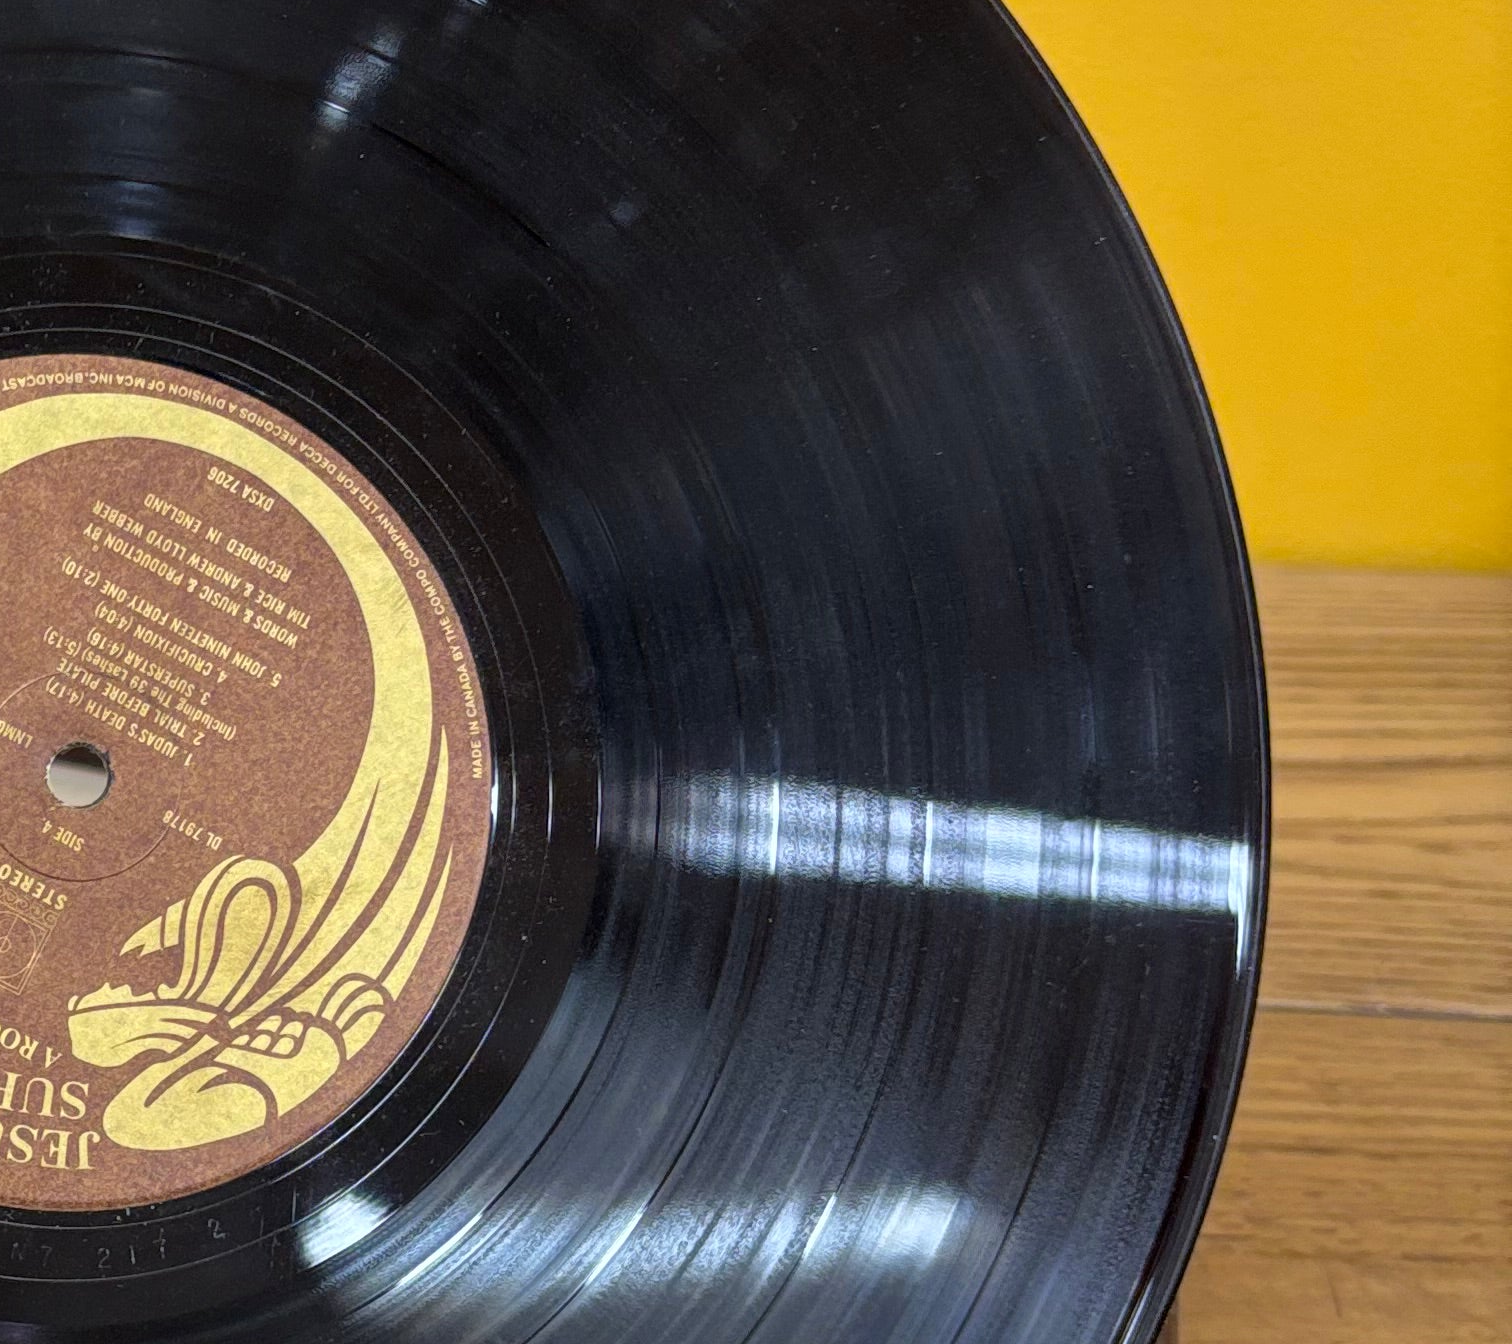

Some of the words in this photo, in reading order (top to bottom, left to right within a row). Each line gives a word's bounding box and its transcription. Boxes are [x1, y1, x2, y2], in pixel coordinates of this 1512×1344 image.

[115, 373, 145, 388] MCA
[168, 383, 226, 409] DIVISION
[238, 407, 297, 446] RECORDS
[299, 441, 337, 474] DECCA
[207, 466, 240, 493] 7206
[241, 484, 274, 511] DXSA
[92, 499, 143, 537] WEBBER
[143, 493, 202, 533] ENGLAND
[82, 522, 102, 541] BY
[145, 529, 186, 560] LLOYD
[205, 526, 222, 544] IN
[375, 513, 419, 567] COMPANY
[103, 532, 184, 585] PRODUCTION
[186, 552, 241, 589] ANDREW
[226, 538, 291, 582] RECORDED
[186, 577, 198, 592] &
[243, 581, 254, 597] &
[415, 569, 445, 615] COMPO
[198, 585, 240, 616] MUSIC
[242, 608, 254, 623] &
[254, 589, 286, 614] RICE
[252, 615, 297, 648] WORDS
[286, 606, 310, 629] TIM
[439, 615, 456, 642] THE
[132, 624, 213, 676] CRUCIFIXION
[169, 617, 231, 659] NINETEEN
[449, 645, 463, 661] BY
[55, 656, 101, 690] PILATE
[123, 649, 195, 697] SUPERSTAR
[231, 651, 266, 678] JOHN
[129, 674, 148, 693] 39
[150, 686, 172, 708] The
[456, 663, 477, 717] CANADA
[84, 699, 126, 730] DEATH
[101, 682, 150, 717] BEFORE
[153, 709, 187, 738] TRIAL
[52, 826, 84, 851] SIDE
[162, 809, 203, 840] 79178
[206, 831, 222, 850] DL
[44, 1046, 62, 1068] A
